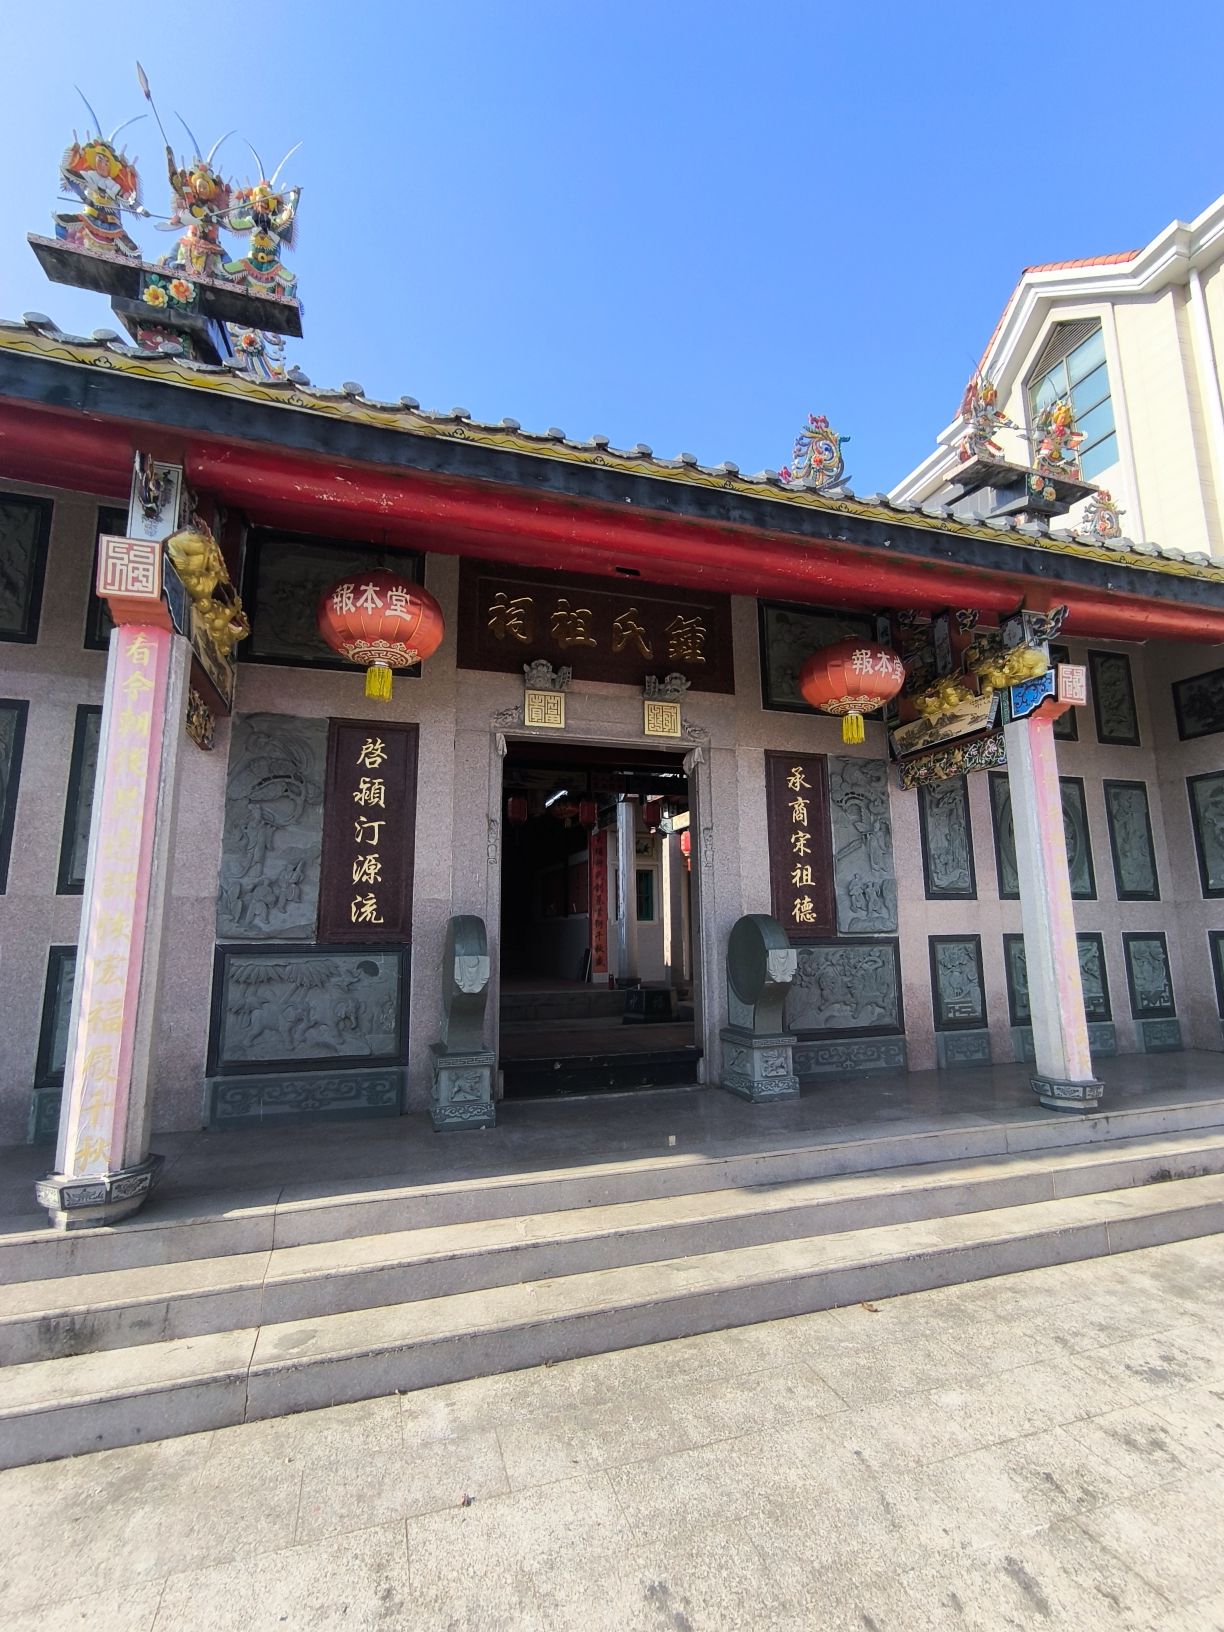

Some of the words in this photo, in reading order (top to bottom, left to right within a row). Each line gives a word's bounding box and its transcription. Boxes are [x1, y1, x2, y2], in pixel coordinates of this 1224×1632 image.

[331, 582, 413, 621] 報本堂
[786, 766, 818, 923] 承商宋祖德
